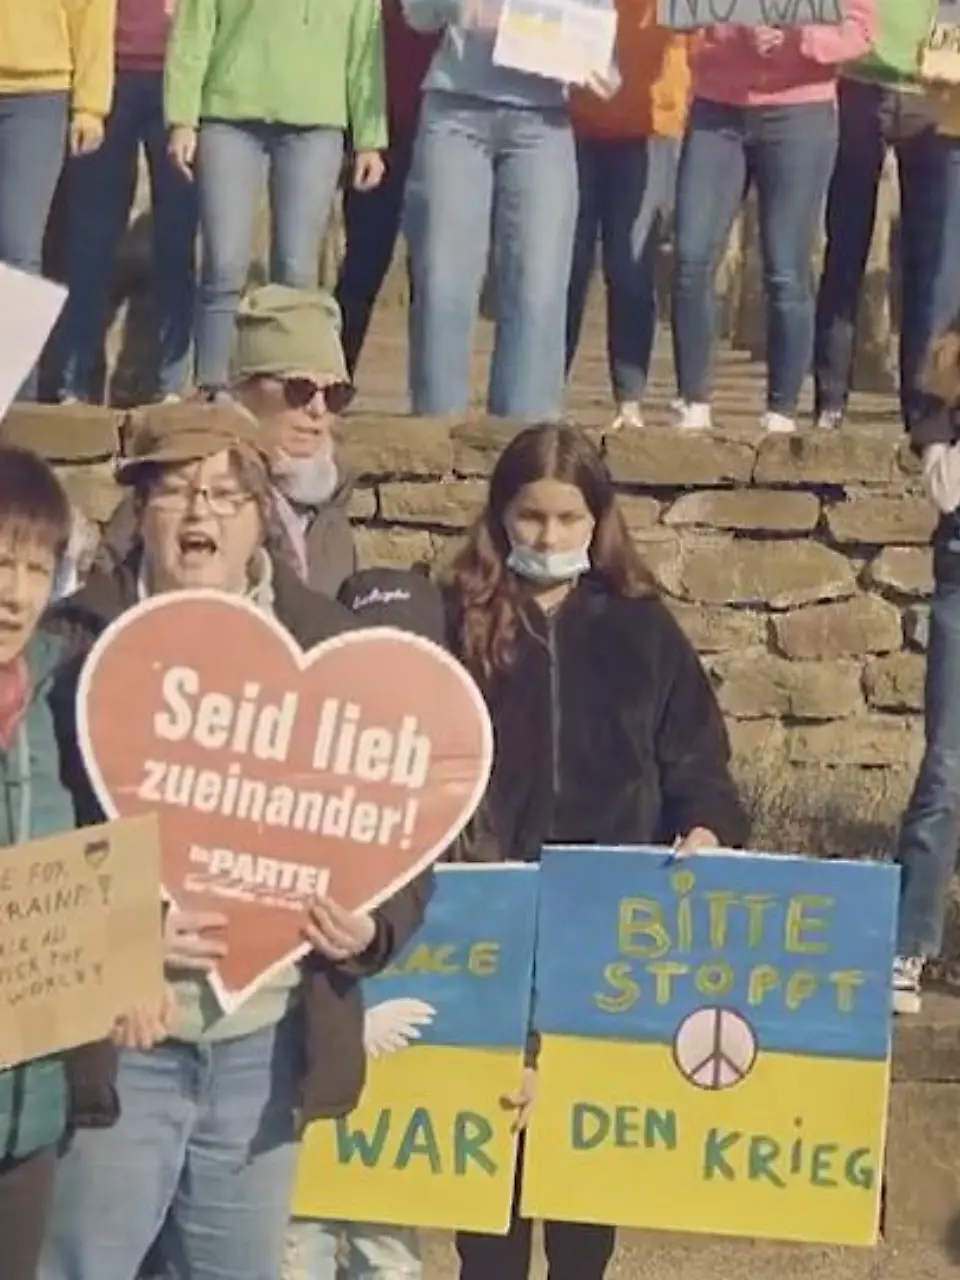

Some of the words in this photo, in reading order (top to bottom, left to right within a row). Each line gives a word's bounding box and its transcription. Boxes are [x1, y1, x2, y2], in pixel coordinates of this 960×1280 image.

[153, 666, 298, 761] Seid
[312, 697, 431, 788] lieb
[137, 759, 418, 850] zueinander!
[208, 848, 331, 900] PARTEI
[593, 959, 867, 1013] STOPPT
[335, 1107, 498, 1176] WAR
[571, 1102, 677, 1150] DEN
